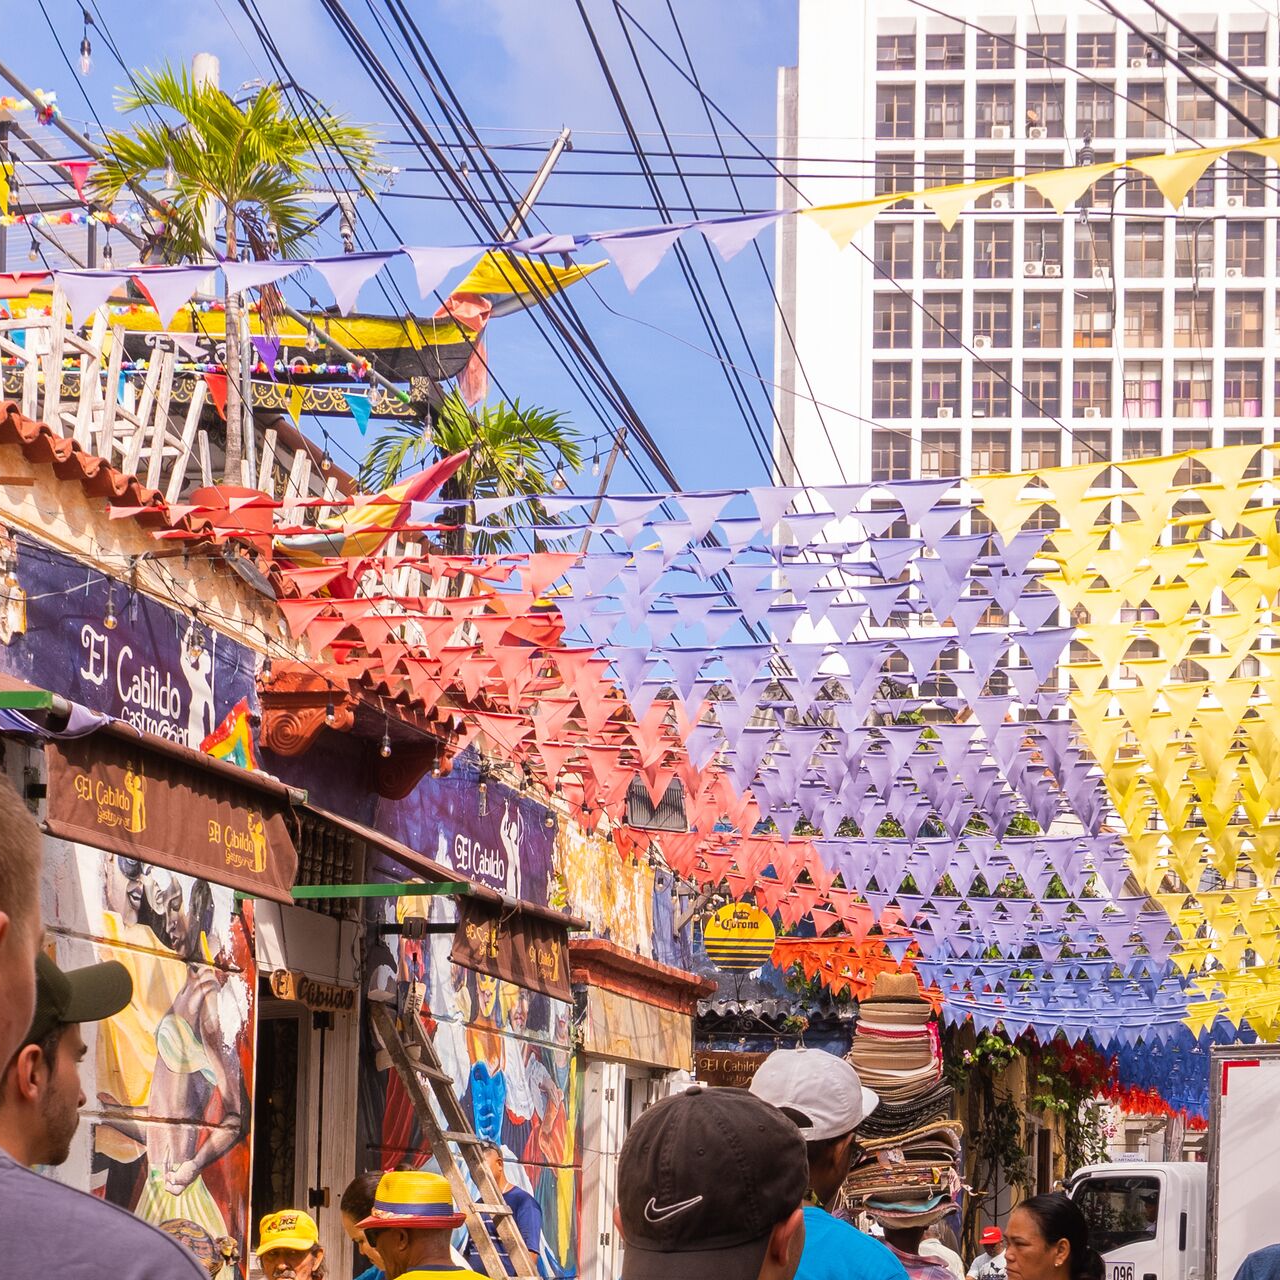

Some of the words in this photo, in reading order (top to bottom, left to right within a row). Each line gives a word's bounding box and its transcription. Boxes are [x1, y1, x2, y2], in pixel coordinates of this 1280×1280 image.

[80, 624, 108, 686] El
[116, 645, 181, 720] Cabildo
[74, 775, 93, 800] El
[95, 780, 130, 811] Cabildo
[224, 825, 254, 853] Cabildo
[455, 834, 471, 870] El
[473, 842, 505, 881] Cabildo
[721, 918, 759, 932] Corona
[700, 1058, 719, 1072] El
